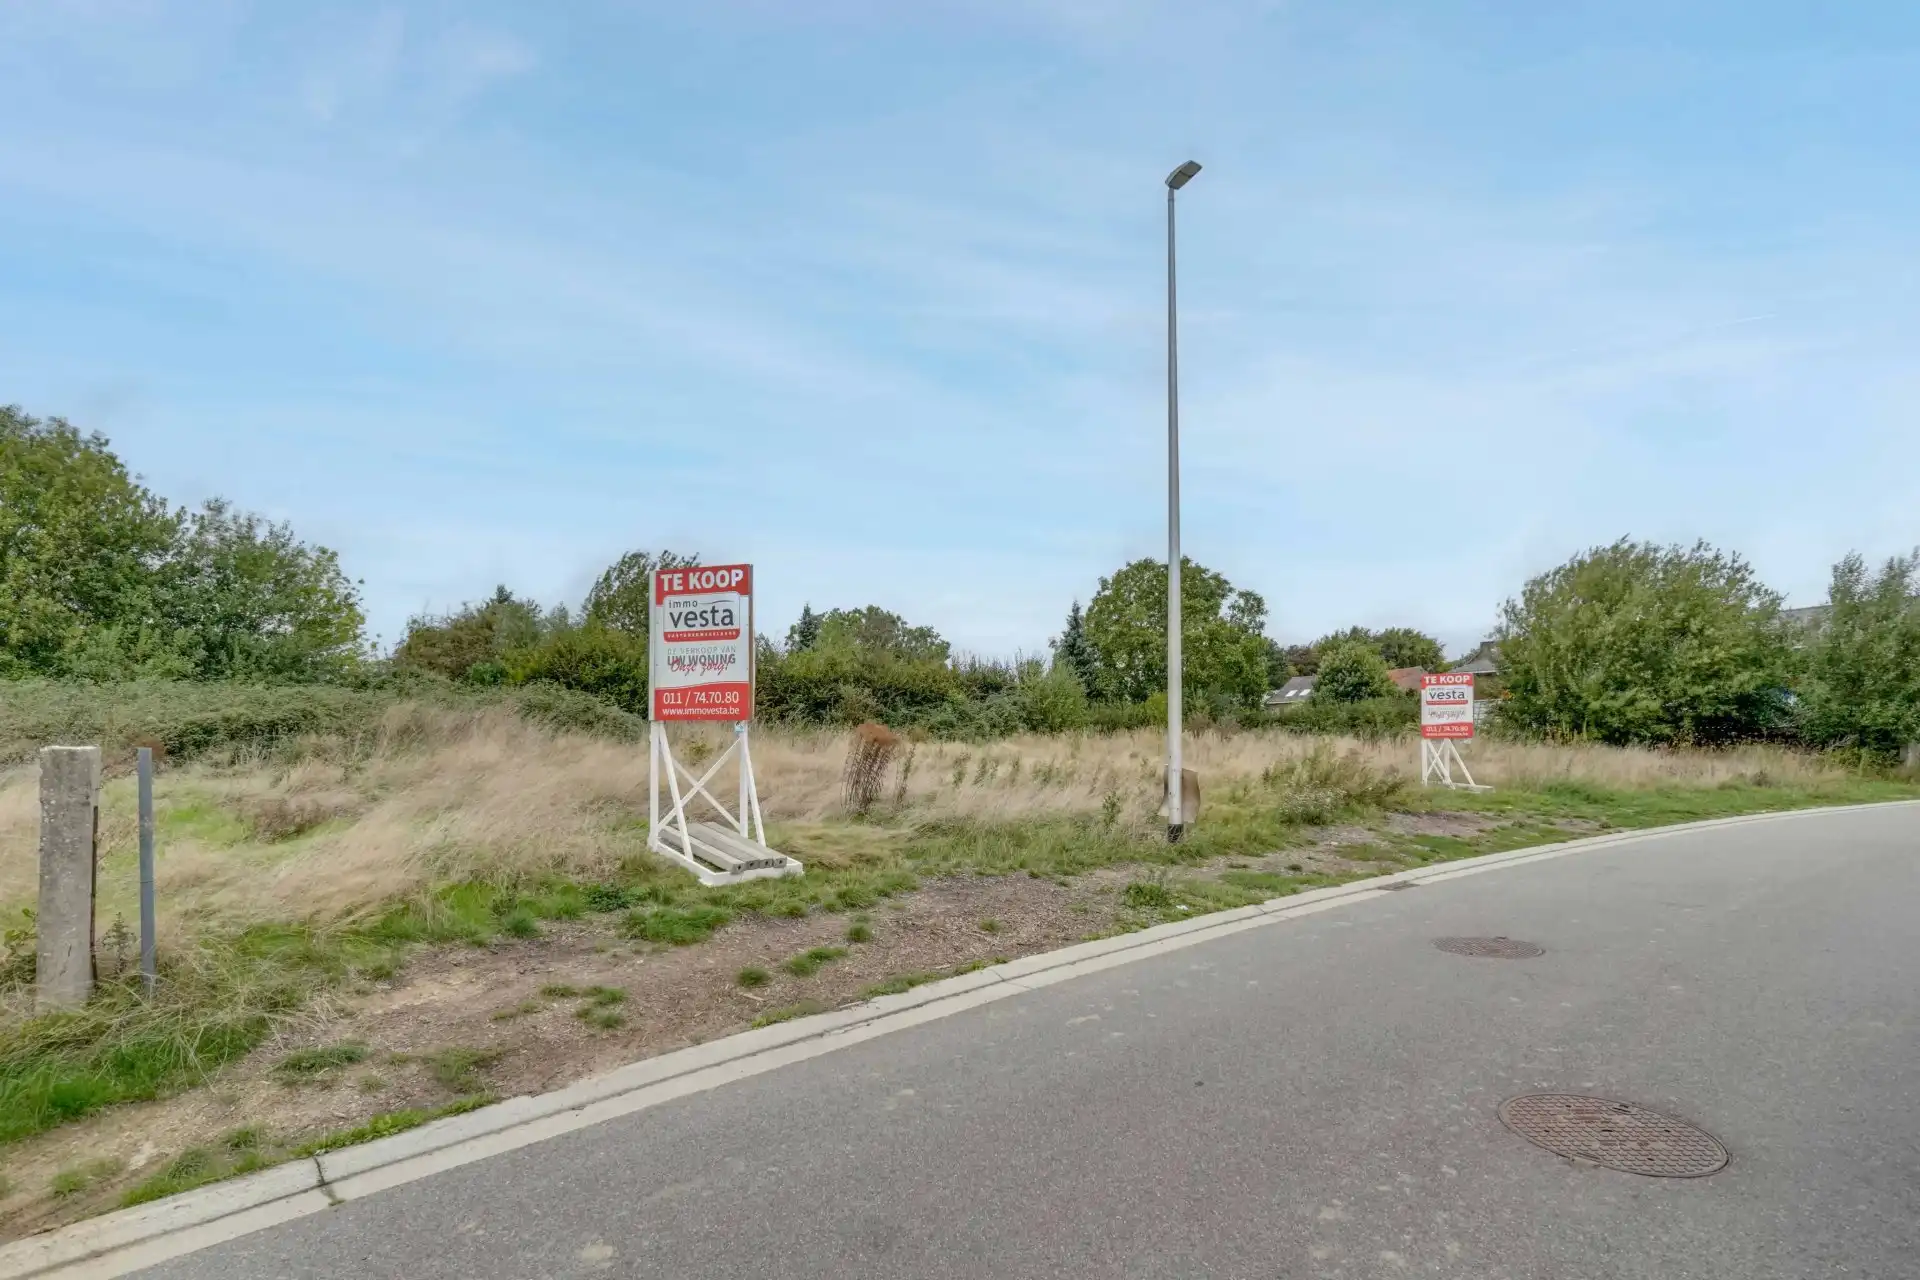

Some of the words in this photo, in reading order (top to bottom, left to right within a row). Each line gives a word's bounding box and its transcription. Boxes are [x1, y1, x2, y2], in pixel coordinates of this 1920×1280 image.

[660, 573, 683, 591] TE
[688, 569, 743, 590] KOOP
[668, 600, 698, 608] immo
[669, 605, 734, 628] vesta
[680, 646, 717, 655] VERKOOP
[721, 645, 736, 653] VAN
[667, 655, 685, 666] UW
[688, 654, 736, 666] WONING
[1424, 676, 1437, 684] TE
[1440, 675, 1470, 684] KOOP
[663, 692, 682, 704] 011
[685, 691, 691, 707] /
[693, 691, 739, 704] 74.70.80
[1429, 690, 1465, 700] vesta
[662, 706, 740, 715] www.immovesta.be
